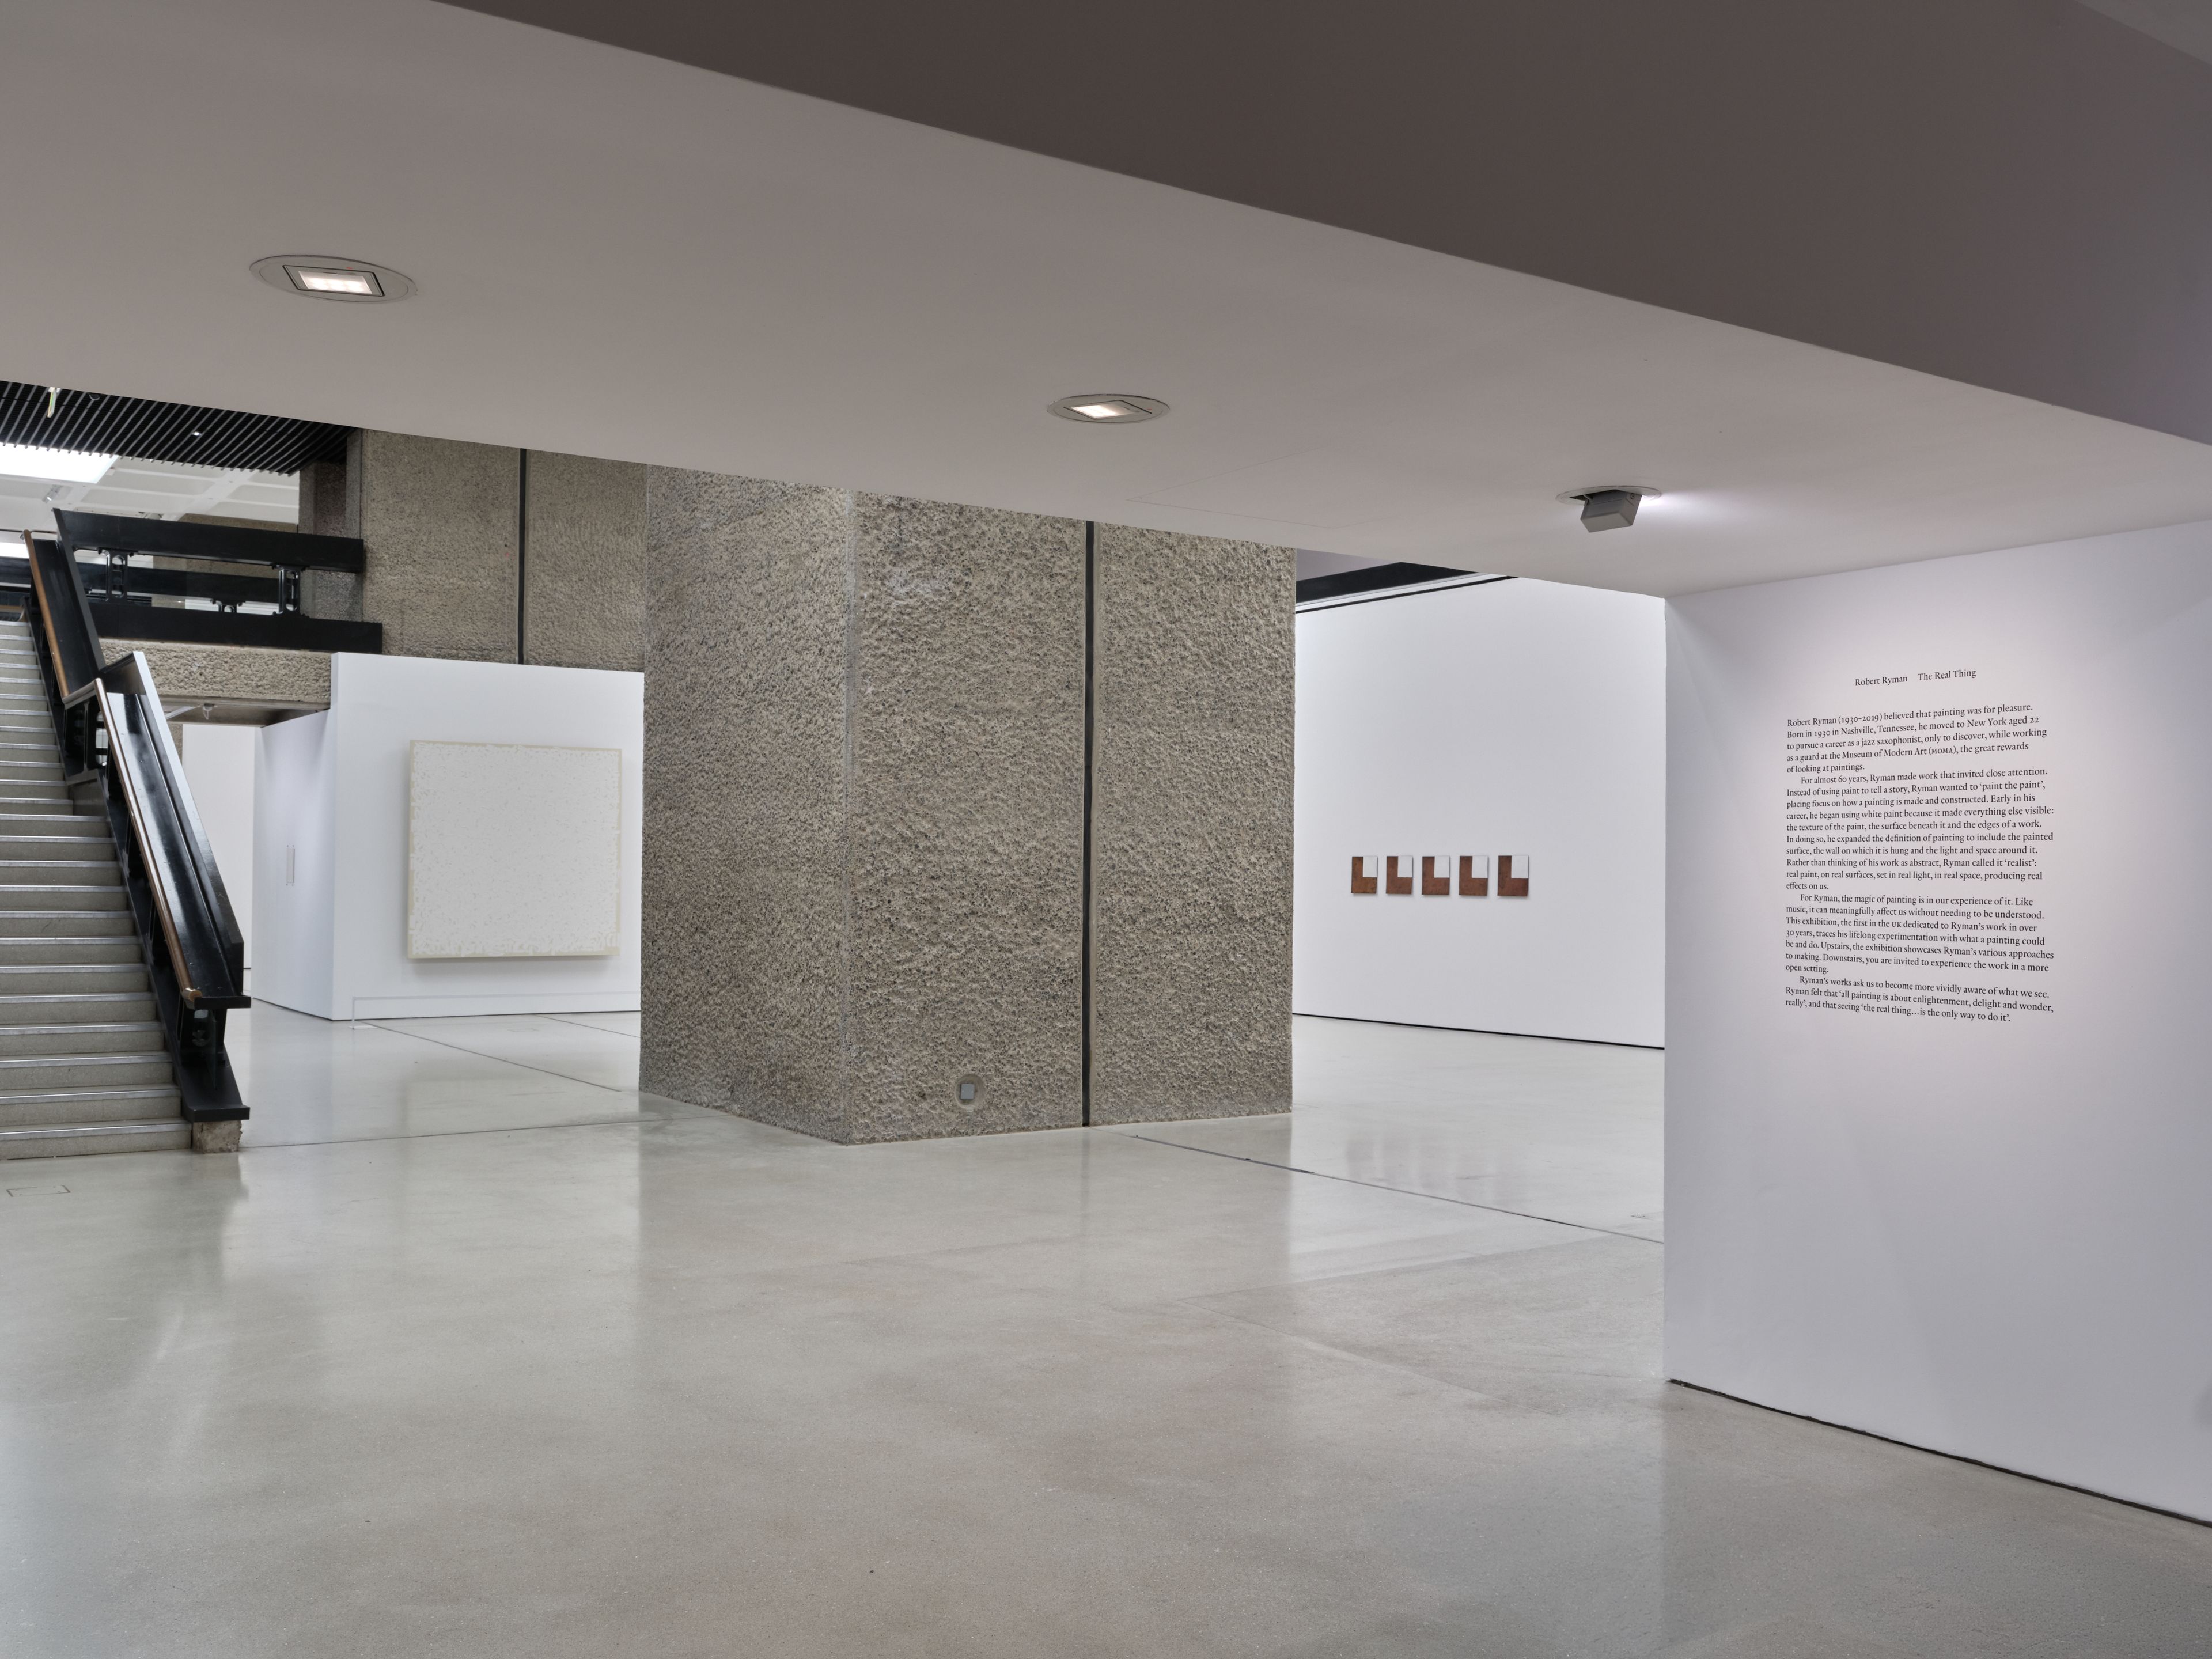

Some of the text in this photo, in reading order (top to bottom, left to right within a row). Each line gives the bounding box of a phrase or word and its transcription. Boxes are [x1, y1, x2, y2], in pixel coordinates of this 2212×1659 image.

[1855, 669, 1976, 686] Robert Ryman The Real Thing
[1805, 729, 1812, 737] in
[1815, 730, 1831, 738] 1930
[1840, 725, 1876, 735] Nashville,
[1877, 725, 1917, 733] Tennessee,
[1918, 722, 1927, 730] he
[1929, 720, 1955, 730] moved
[1967, 719, 1986, 728] New
[1987, 717, 2007, 726] York
[2008, 715, 2028, 727] aged
[1796, 743, 1819, 752] pursue
[1861, 738, 1876, 748] jazz
[1877, 735, 1923, 747] saxophonist,
[1924, 733, 1941, 744] only
[1952, 732, 1987, 741] discover,
[1988, 729, 2011, 738] while
[2012, 728, 2047, 738] working
[1786, 765, 1795, 773] of
[1796, 764, 1821, 774] looking
[1831, 763, 1865, 774] paintings.
[1813, 776, 1837, 784] almost
[1838, 775, 1847, 783] 60
[1848, 776, 1869, 785] years,
[1870, 774, 1895, 783] Ryman
[1897, 772, 1917, 781] made
[1918, 771, 1938, 780] work
[1940, 771, 1956, 779] that
[1957, 769, 1984, 778] invited
[1986, 768, 2006, 777] close
[2008, 767, 2048, 777] attention.
[1786, 800, 1810, 810] placing
[1812, 799, 1830, 808] focus
[1842, 798, 1858, 806] how
[1865, 798, 1895, 808] painting
[1896, 797, 1902, 805] is
[1904, 796, 1923, 805] made
[1925, 796, 1939, 804] and
[1940, 794, 1988, 804] constructed.
[1990, 794, 2012, 805] Early
[2013, 794, 2021, 802] in
[2023, 793, 2035, 802] his
[1809, 811, 1818, 819] he
[1819, 811, 1839, 821] began
[1841, 810, 1861, 820] using
[1861, 810, 1882, 818] white
[1884, 809, 1903, 820] paint
[1904, 809, 1933, 817] because
[1934, 808, 1941, 817] it
[1942, 808, 1963, 816] made
[1964, 807, 2006, 818] everything
[2008, 806, 2023, 815] else
[2025, 806, 2054, 815] visible:
[1795, 835, 1815, 844] doing
[1827, 835, 1836, 843] he
[1836, 834, 1870, 844] expanded
[1872, 834, 1884, 842] the
[1885, 834, 1921, 842] definition
[1922, 833, 1933, 842] of
[1933, 833, 1965, 844] painting
[1976, 832, 2006, 841] include
[2008, 832, 2021, 841] the
[2022, 832, 2054, 843] painted
[1786, 870, 1798, 878] real
[1800, 870, 1820, 880] paint,
[1831, 870, 1844, 878] real
[1845, 870, 1876, 880] surfaces,
[1889, 870, 1896, 878] in
[1897, 870, 1911, 879] real
[1913, 870, 1933, 881] light,
[1934, 871, 1942, 879] in
[1944, 871, 1957, 879] real
[1959, 873, 1983, 881] space,
[1984, 871, 2026, 882] producing
[2028, 871, 2043, 880] real
[1786, 881, 1808, 889] effects
[1786, 905, 1808, 914] music,
[1829, 906, 1876, 917] meaningfully
[1877, 907, 1897, 915] affect
[1908, 908, 1939, 916] without
[1940, 908, 1971, 920] needing
[1983, 909, 1993, 918] be
[1995, 910, 2044, 919] understood.
[1786, 930, 1794, 938] 30
[1795, 930, 1815, 938] years,
[1837, 930, 1847, 938] his
[1849, 930, 1876, 941] lifelong
[1877, 932, 1938, 942] experimentation
[1940, 934, 1957, 942] with
[1959, 934, 1979, 943] what
[1987, 935, 2020, 947] painting
[2022, 937, 2045, 945] could
[1786, 940, 2054, 960] be and do. Upstairs, the exhibition showcases Ryman’s various approaches
[1785, 964, 1829, 975] open setting.
[1800, 975, 1829, 986] Ryman’s
[1830, 978, 1852, 986] works
[1853, 979, 1865, 987] ask
[1885, 980, 1914, 990] become
[1936, 983, 1962, 995] vividly
[1988, 986, 1998, 995] of
[1998, 987, 2019, 997] what
